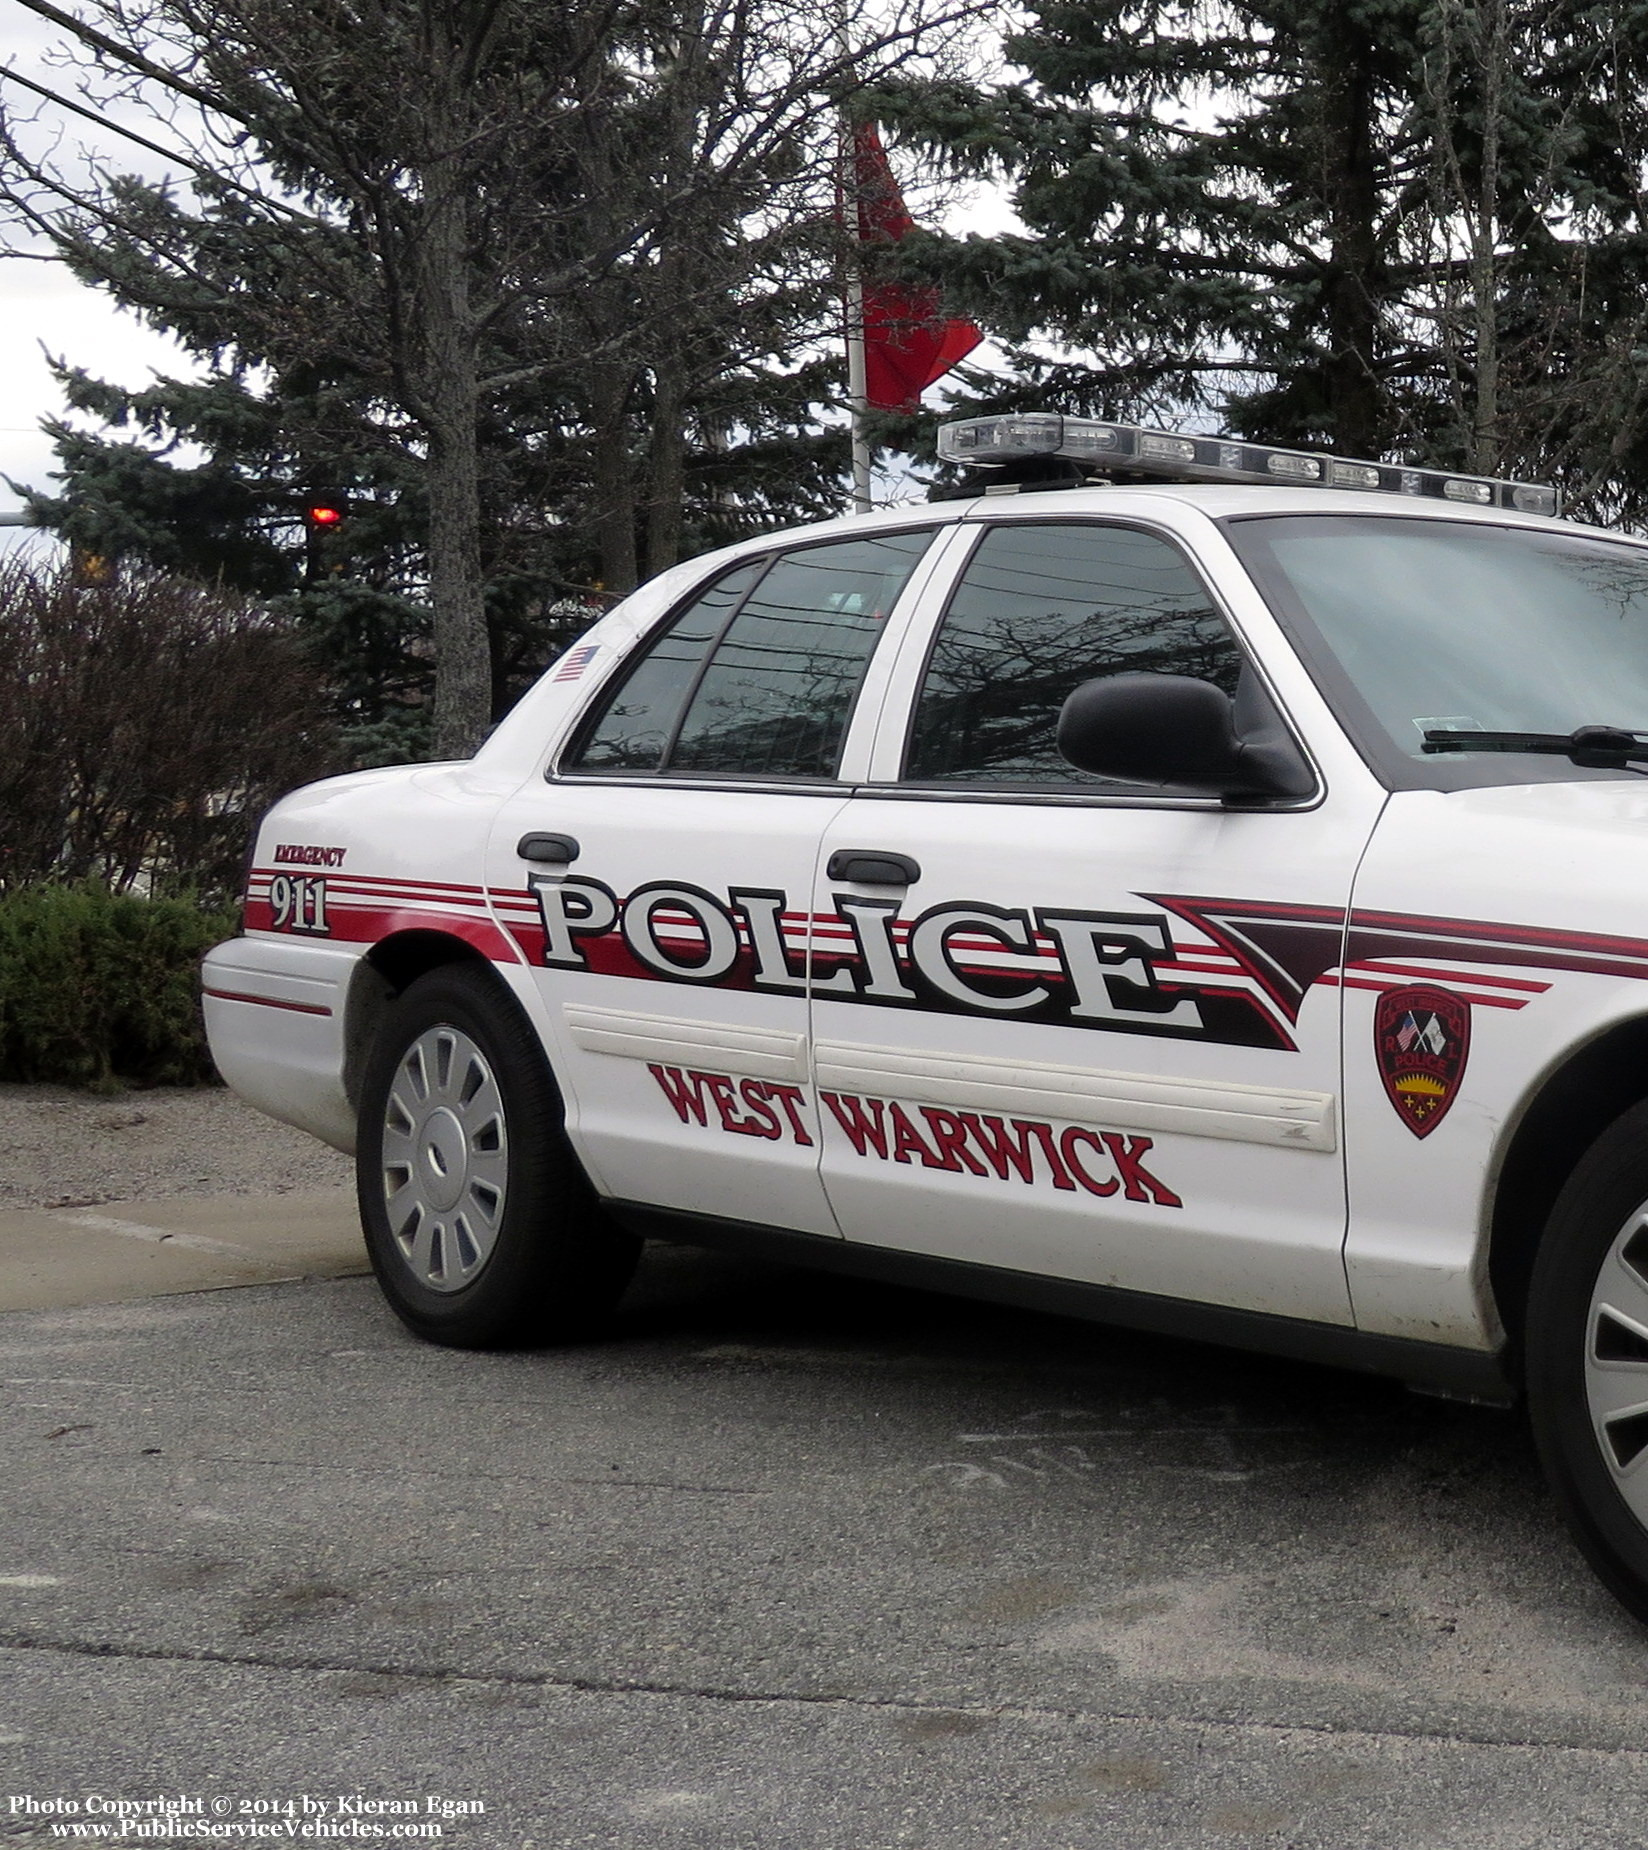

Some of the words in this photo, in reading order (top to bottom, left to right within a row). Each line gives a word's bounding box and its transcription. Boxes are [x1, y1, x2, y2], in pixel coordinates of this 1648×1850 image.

[271, 872, 331, 935] 911
[274, 844, 347, 867] EMERGENCY
[527, 872, 1205, 1030] POLICE
[647, 1063, 813, 1147] WEST
[819, 1091, 1184, 1208] WARWICK
